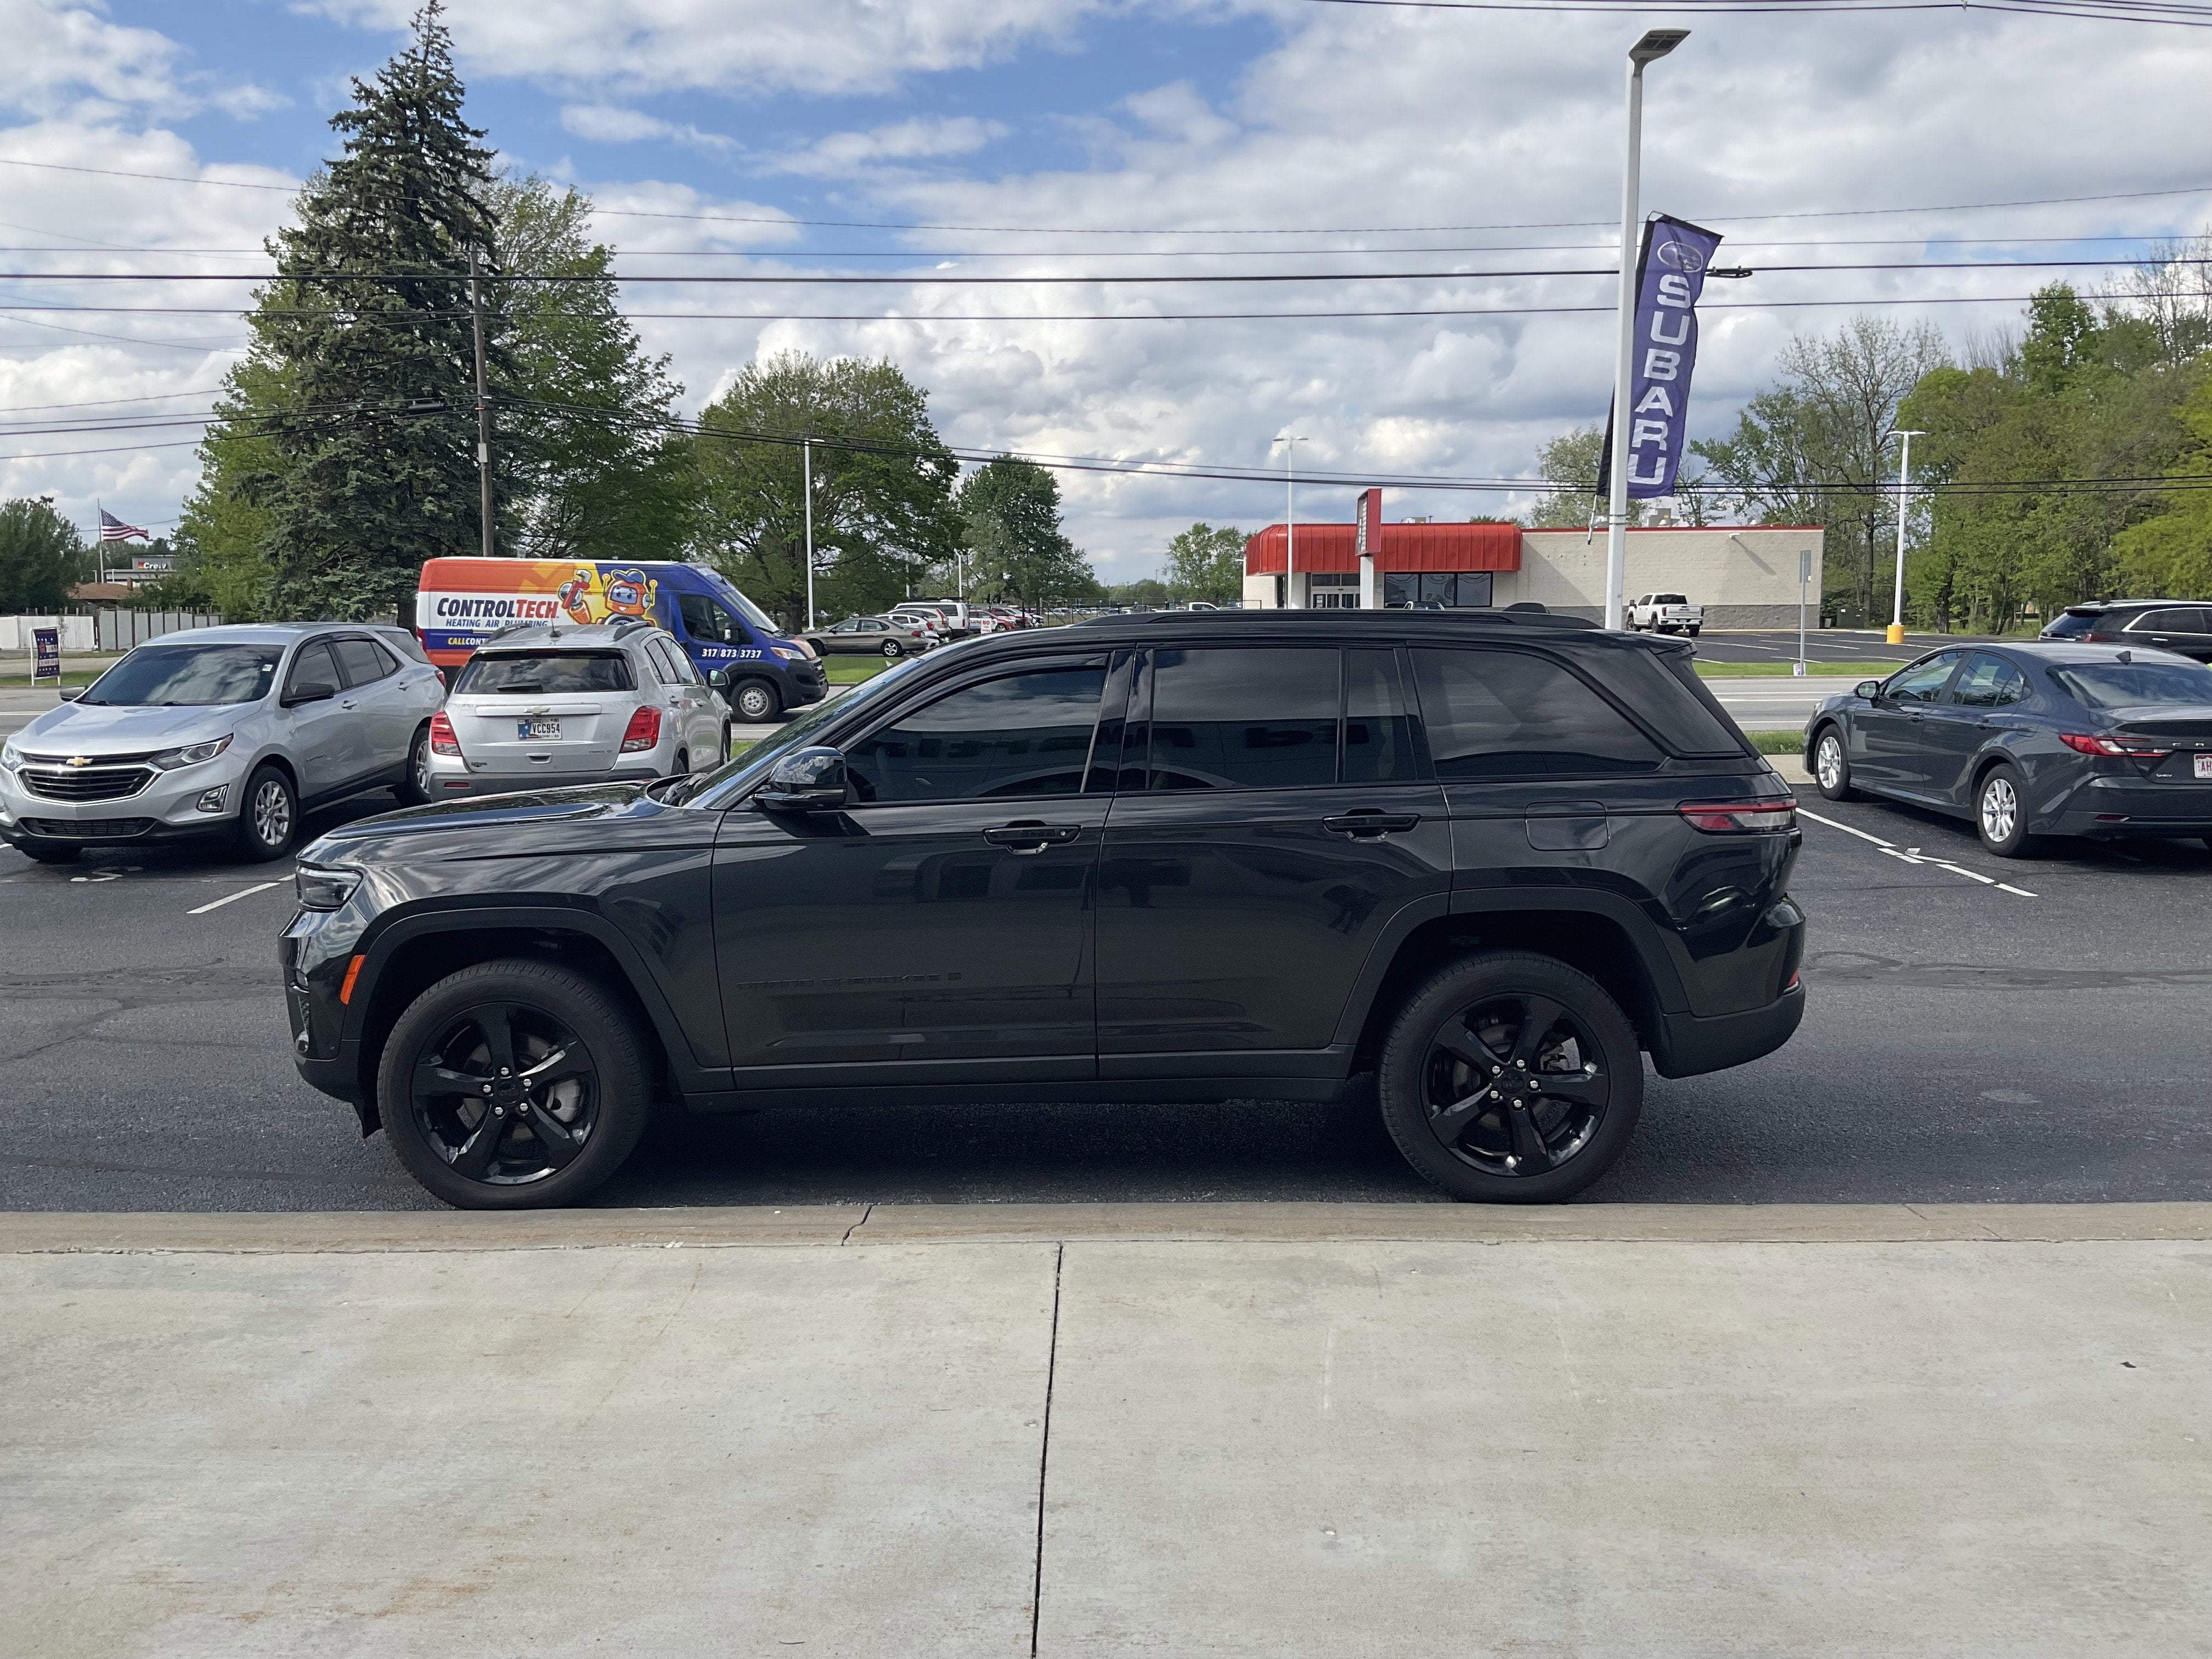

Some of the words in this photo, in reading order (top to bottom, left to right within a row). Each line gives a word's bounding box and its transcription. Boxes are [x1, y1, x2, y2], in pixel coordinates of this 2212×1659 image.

[1627, 274, 1691, 484] SUBARU
[445, 619, 481, 627] HEATING
[532, 724, 560, 733] VCC954
